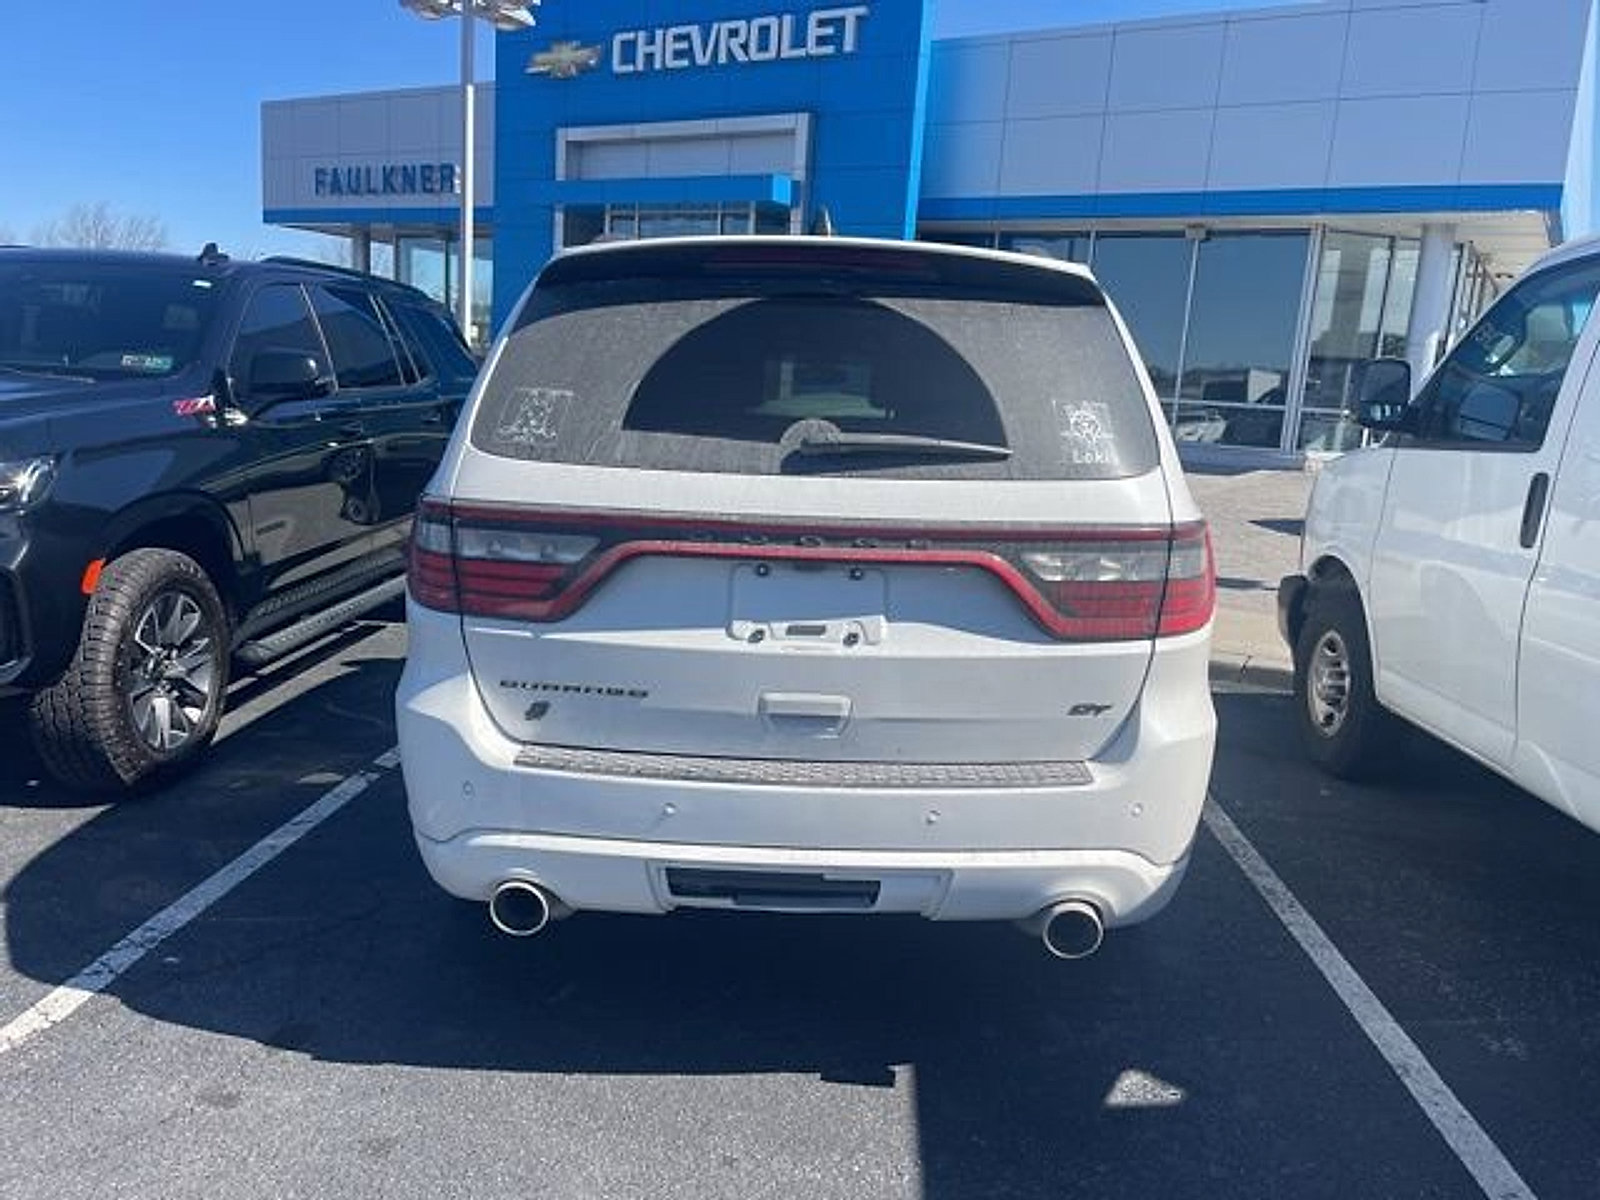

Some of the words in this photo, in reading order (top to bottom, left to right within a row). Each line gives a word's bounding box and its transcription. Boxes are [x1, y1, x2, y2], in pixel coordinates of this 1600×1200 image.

[612, 5, 869, 75] CHEVROLET
[314, 162, 458, 196] FAULKNER
[1066, 702, 1113, 717] GT
